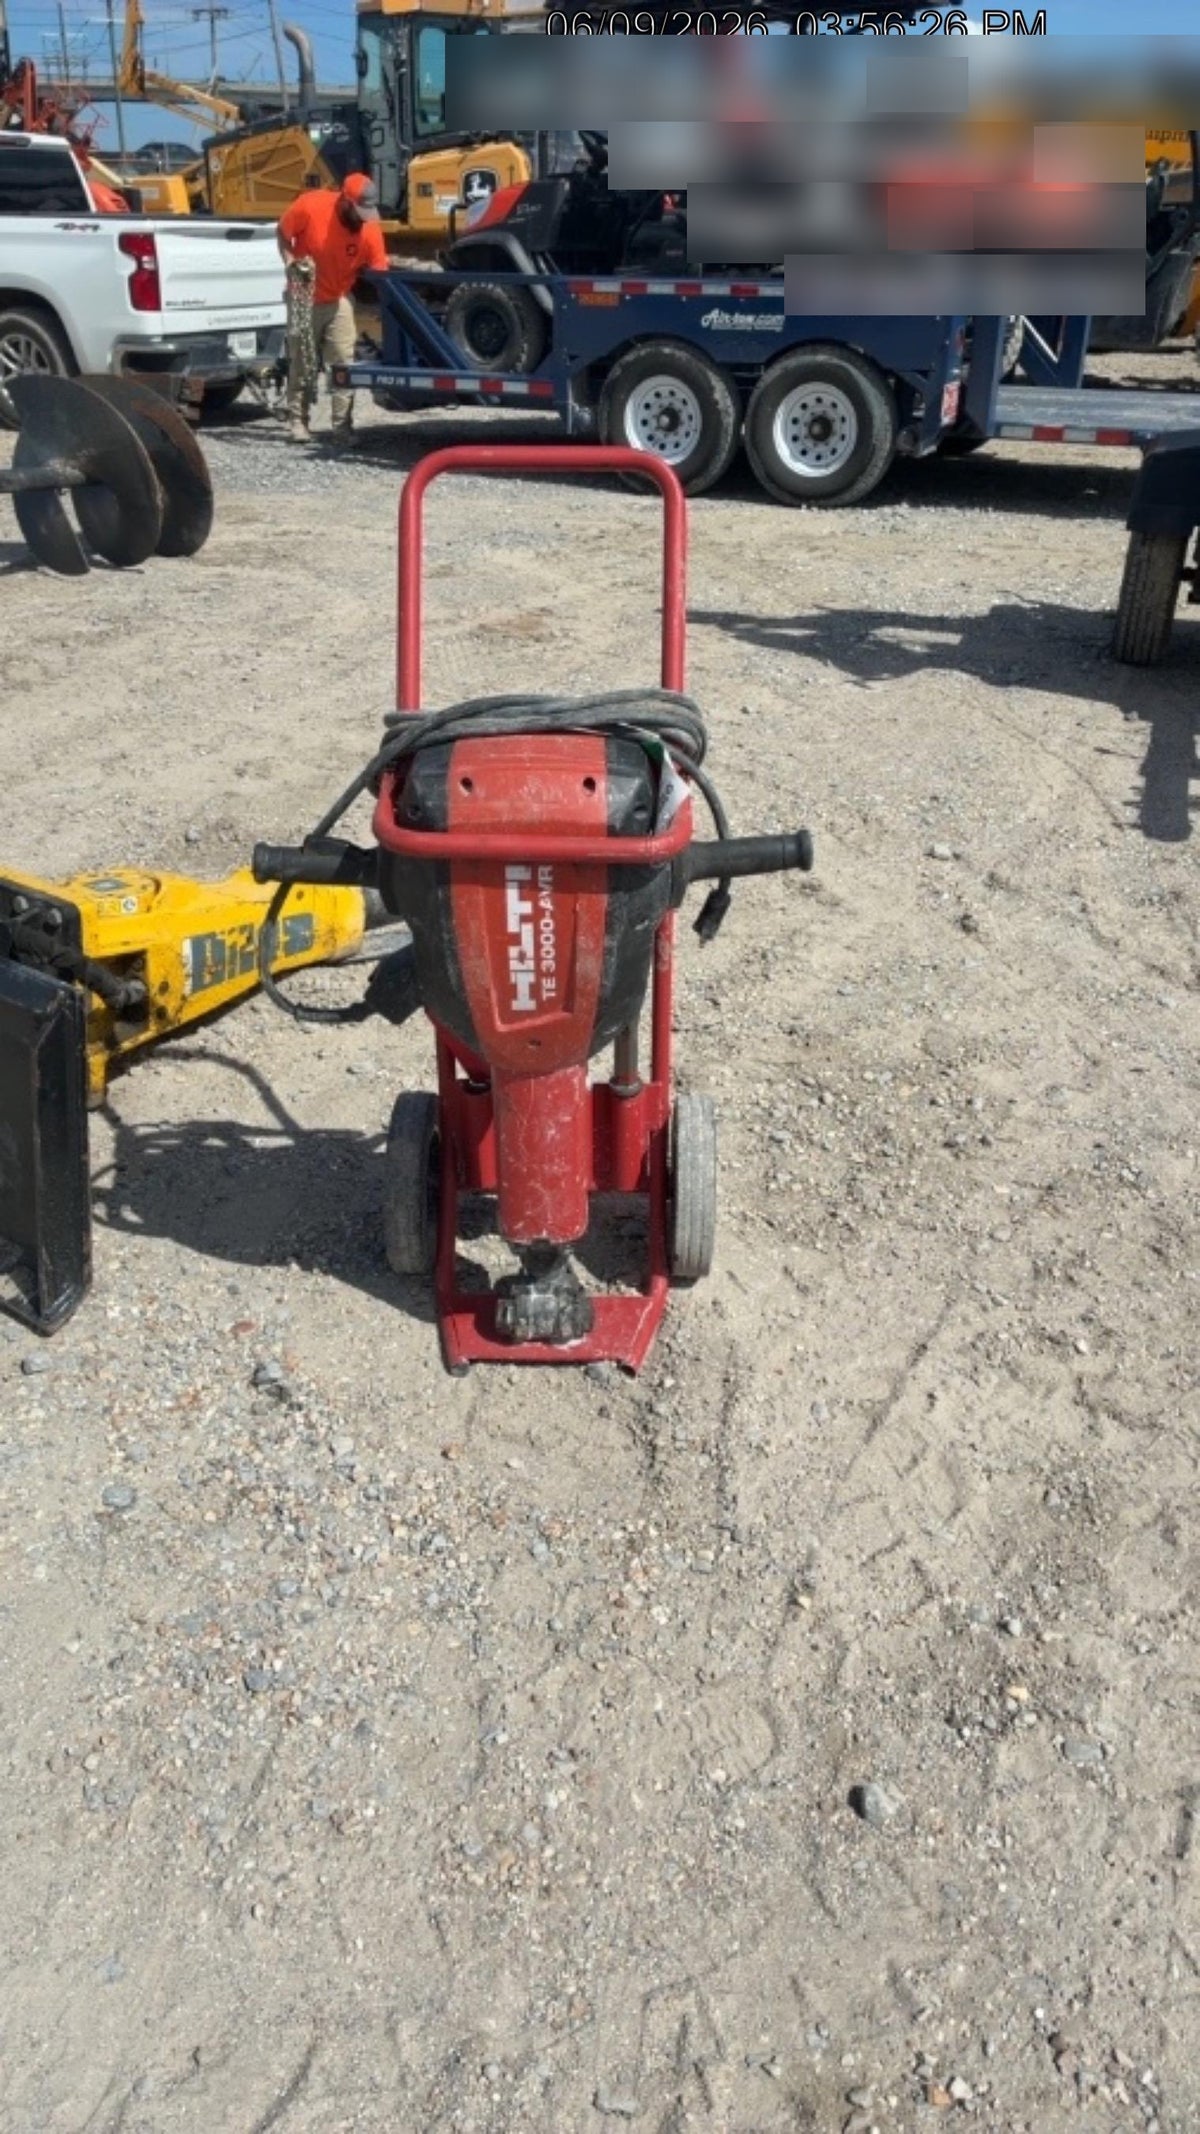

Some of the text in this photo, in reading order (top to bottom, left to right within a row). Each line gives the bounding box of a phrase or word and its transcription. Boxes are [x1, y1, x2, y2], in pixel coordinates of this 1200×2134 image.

[505, 864, 537, 1011] HILTI
[538, 864, 557, 1001] TE 3000-AVR
